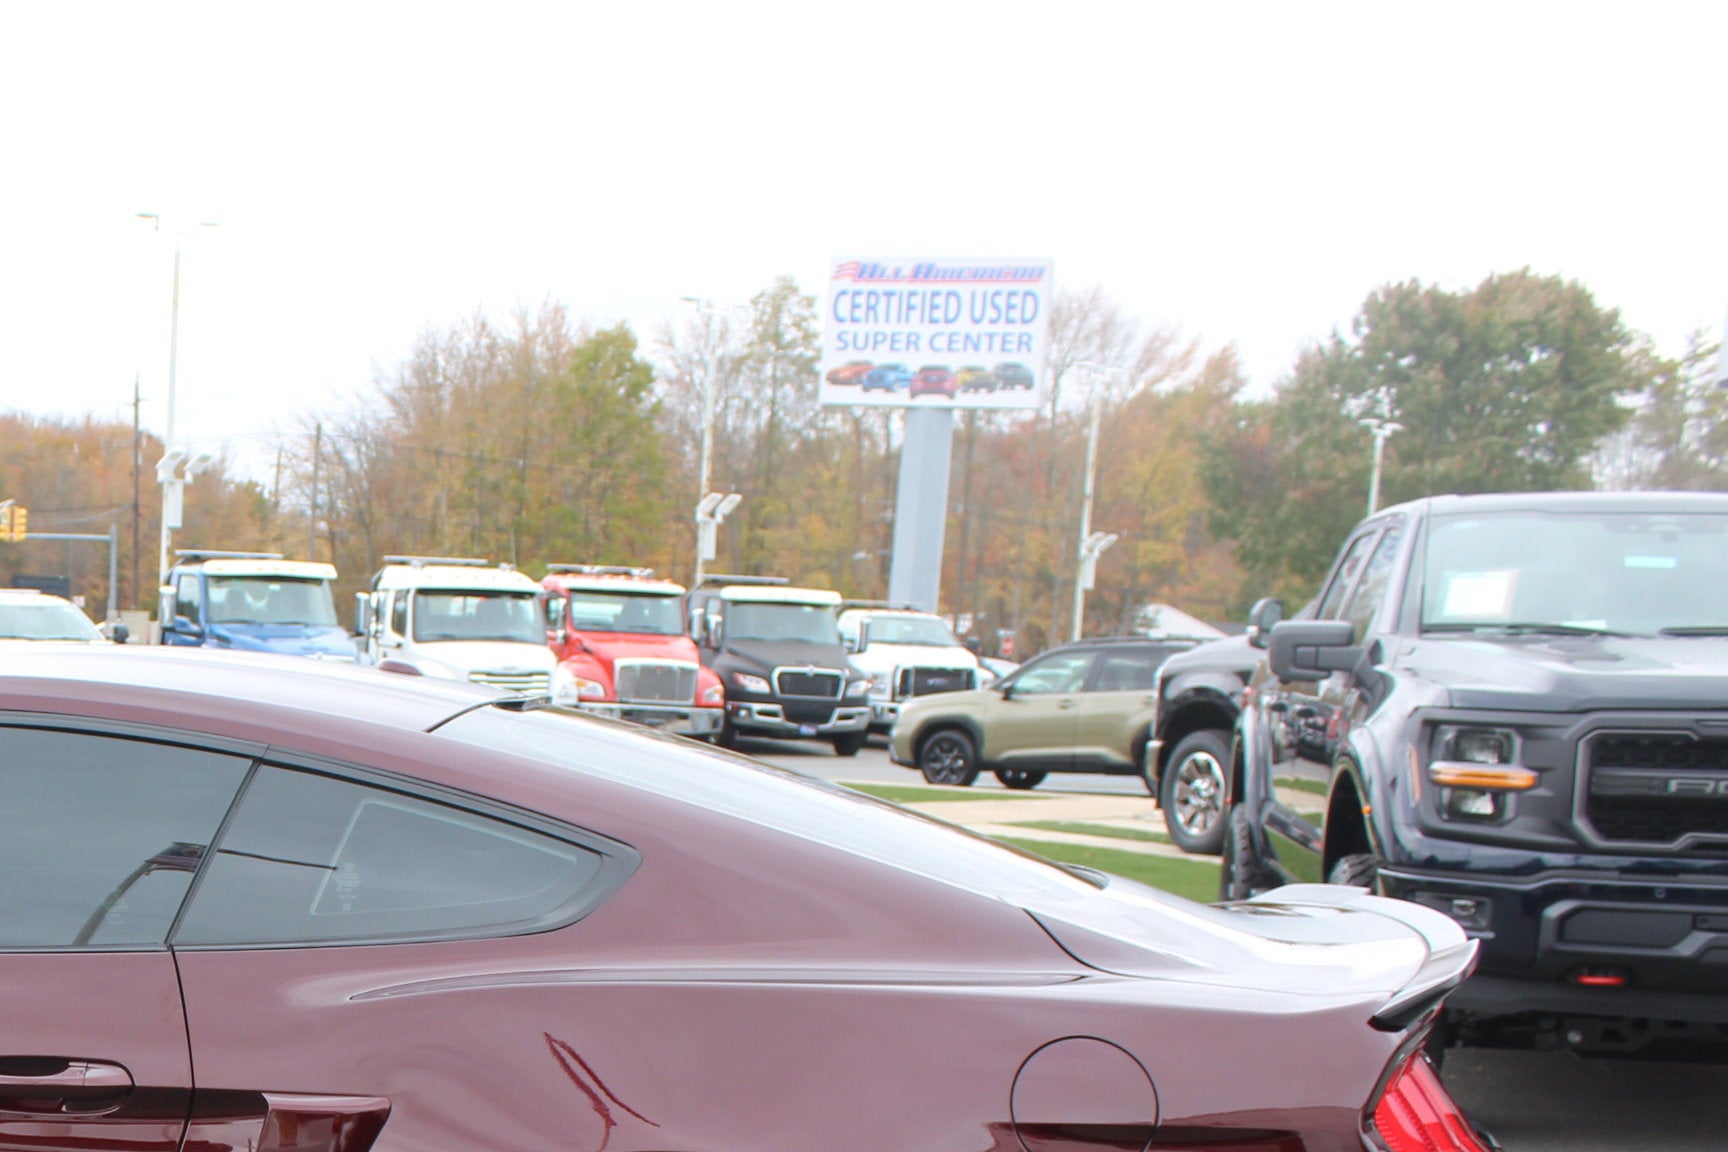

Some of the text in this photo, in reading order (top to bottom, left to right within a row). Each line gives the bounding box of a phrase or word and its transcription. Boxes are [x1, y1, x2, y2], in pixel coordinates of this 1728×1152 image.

[833, 289, 1040, 324] CERTIFIED USED
[836, 331, 1033, 353] SUPER CENTER
